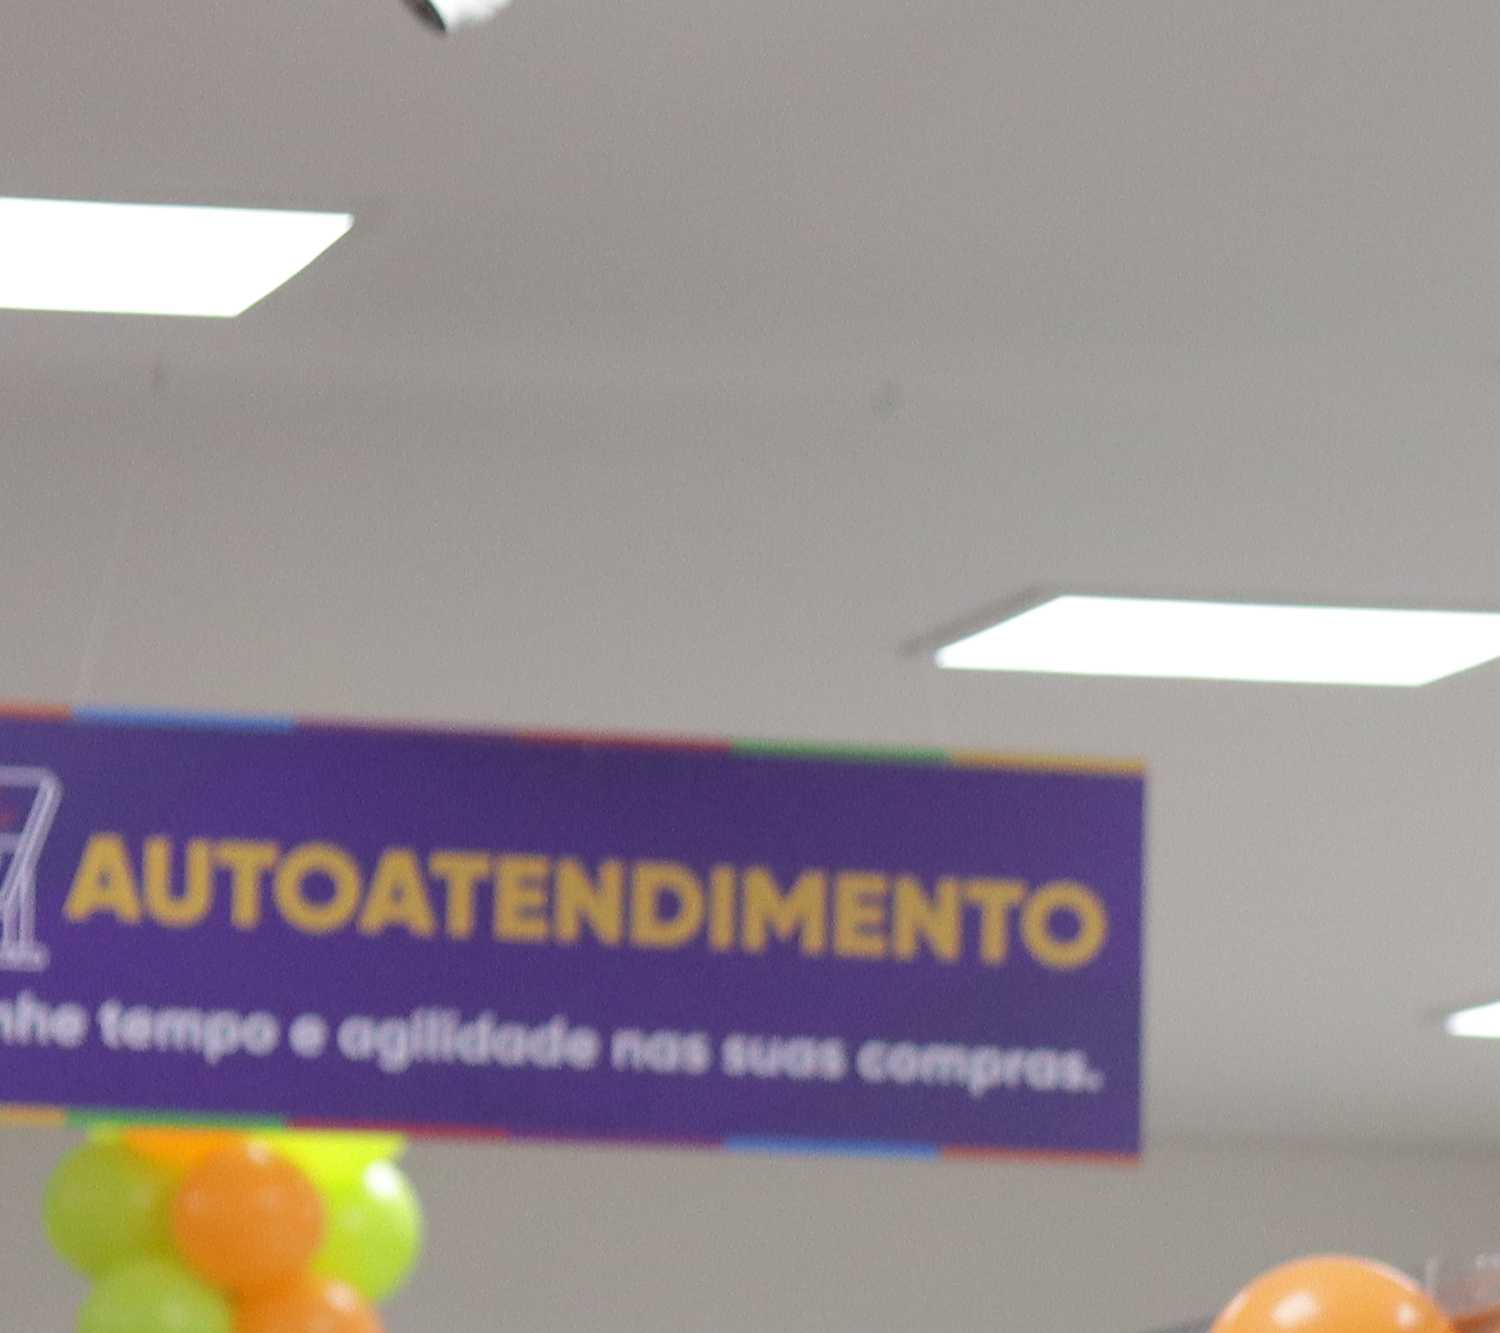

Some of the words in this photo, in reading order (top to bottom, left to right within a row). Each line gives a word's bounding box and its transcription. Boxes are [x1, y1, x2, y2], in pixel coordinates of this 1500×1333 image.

[64, 833, 1107, 969] AUTOATENDIMENTO
[97, 999, 280, 1067] tempo
[289, 1013, 328, 1059] e
[337, 1006, 599, 1073] agilidade
[610, 1027, 711, 1076] nas
[722, 1031, 848, 1082] suas
[856, 1037, 1104, 1098] compras.
